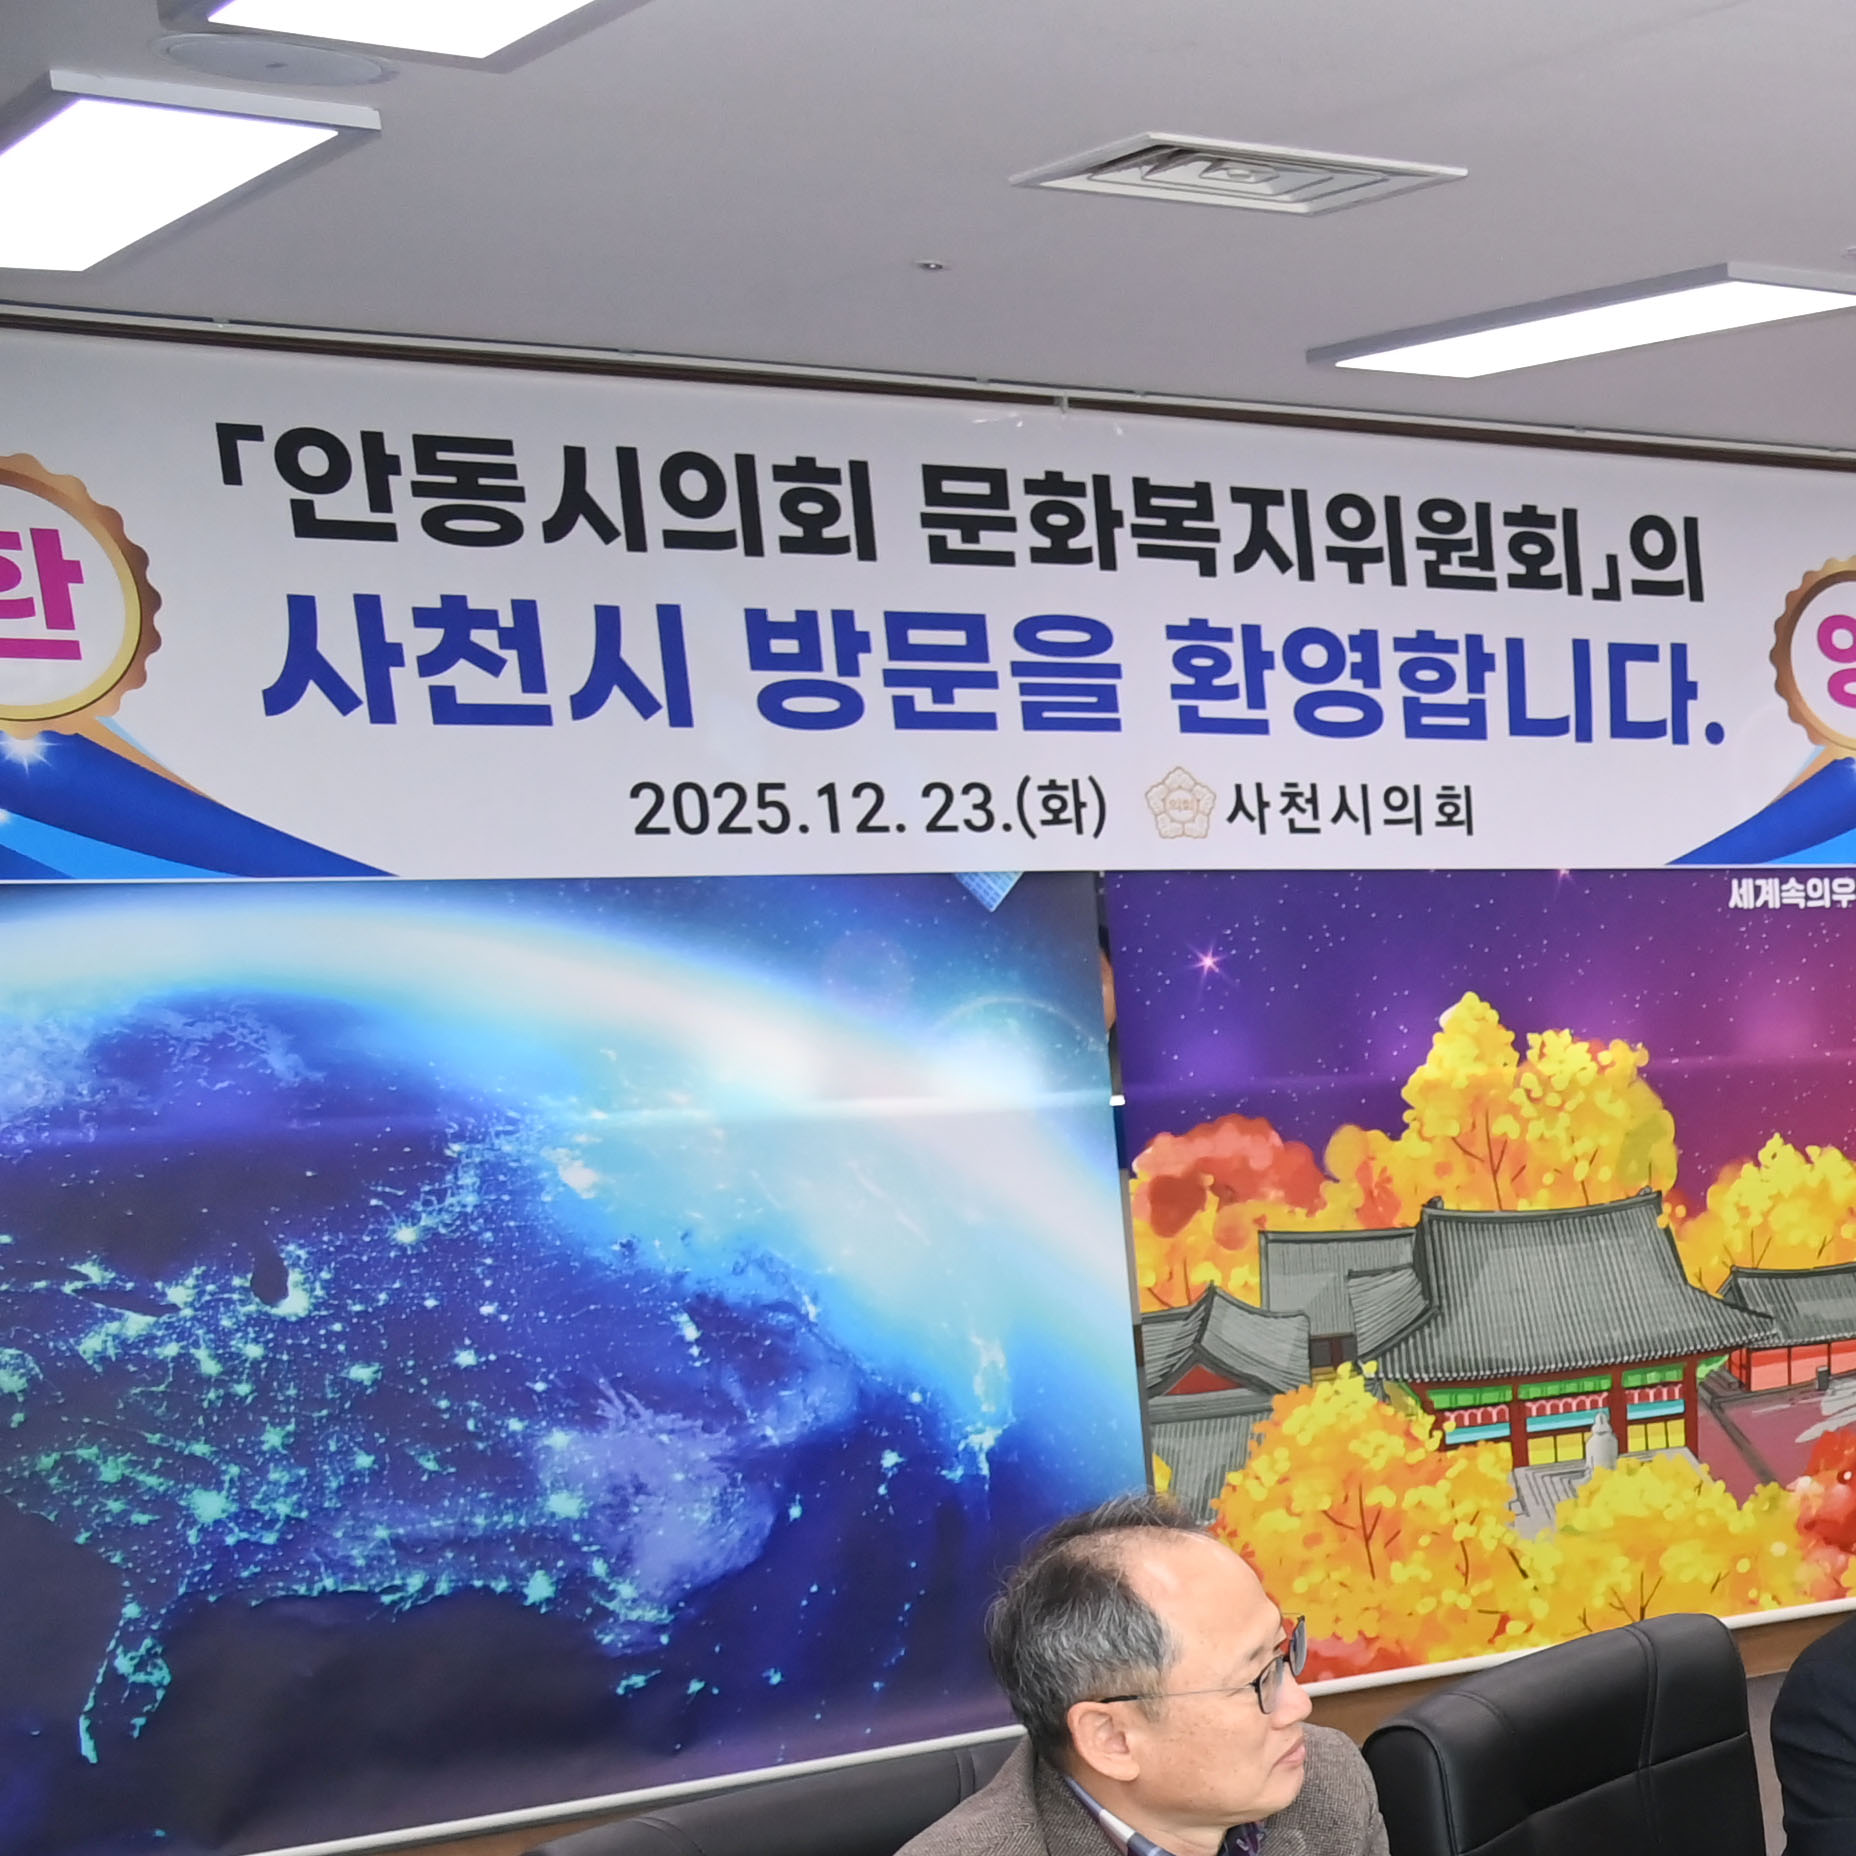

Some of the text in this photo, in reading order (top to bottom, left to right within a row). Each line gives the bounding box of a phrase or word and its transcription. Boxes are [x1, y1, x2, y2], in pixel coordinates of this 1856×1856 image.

[215, 421, 1706, 602] 「안동시의회 문화복지위원회」의
[261, 593, 1726, 747] 사천시 방문을 환영합니다.
[1226, 782, 1474, 836] 사천시의회
